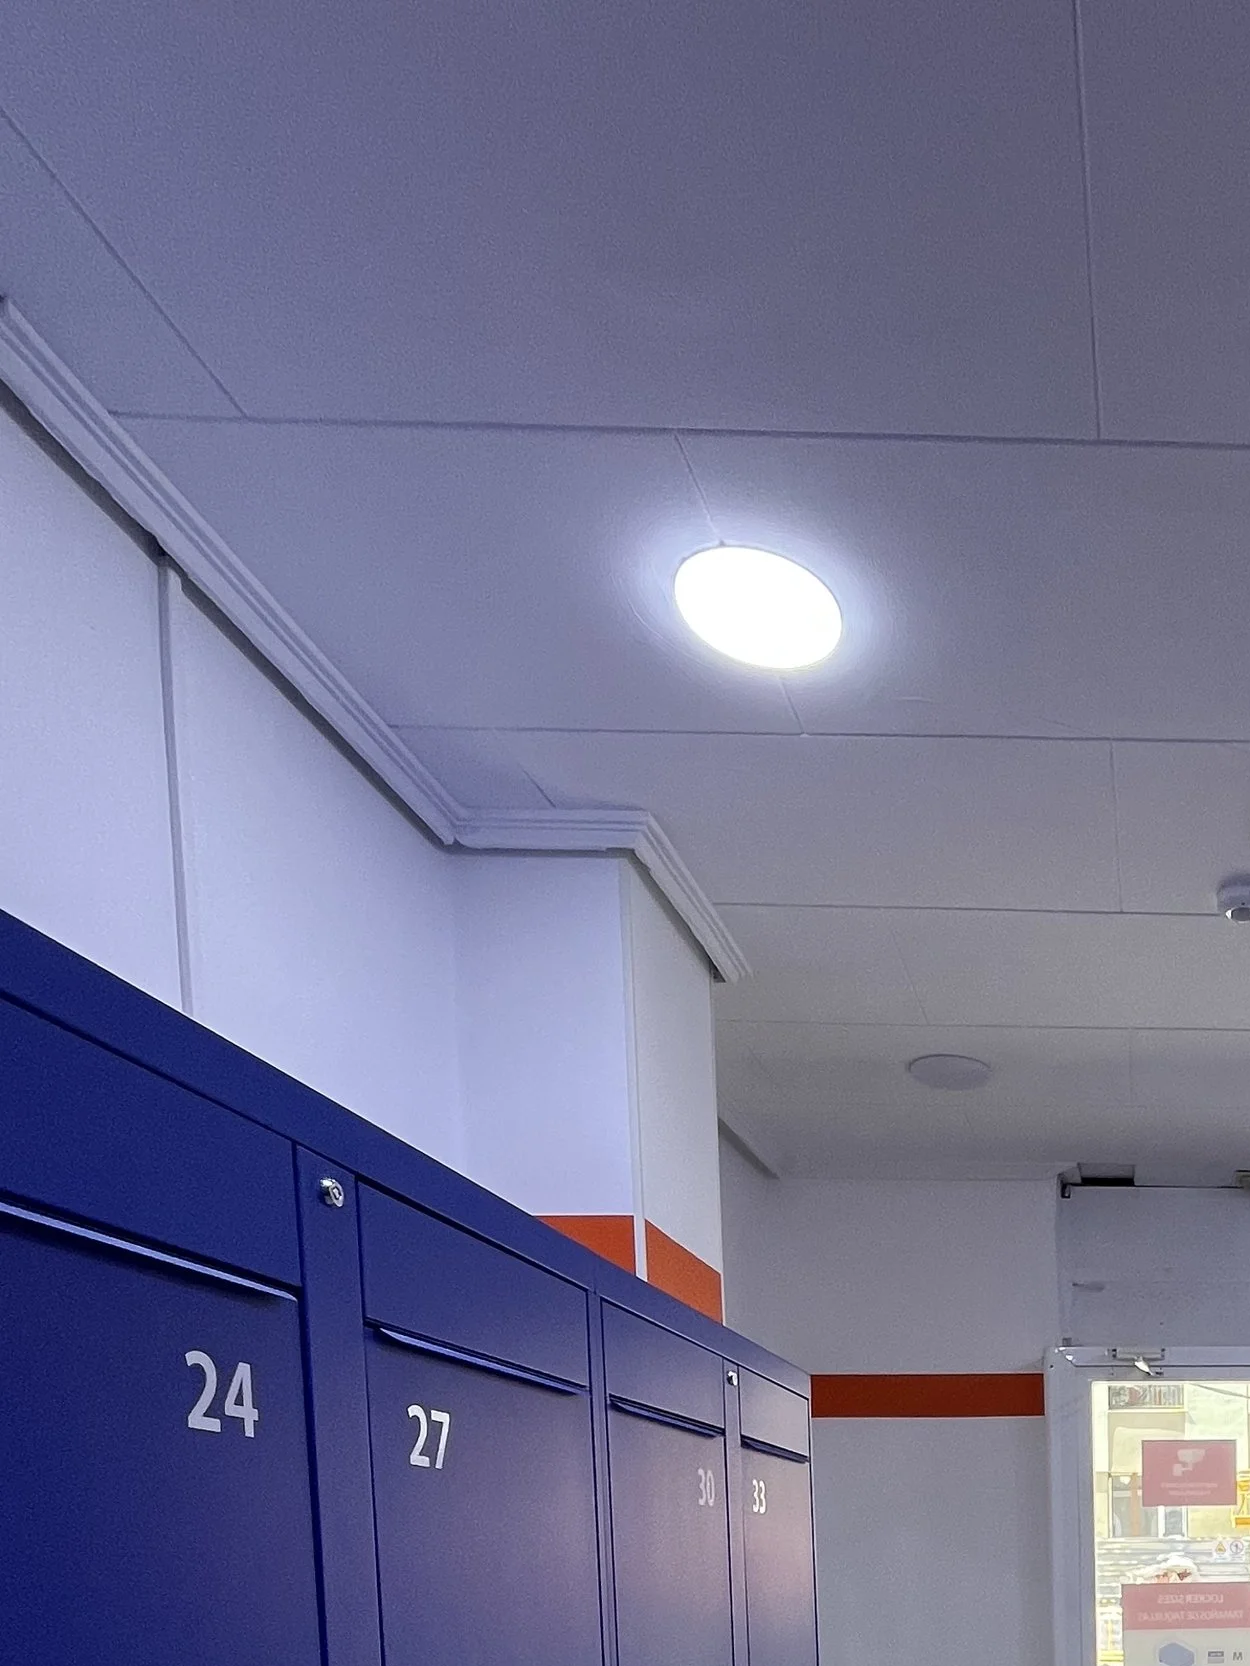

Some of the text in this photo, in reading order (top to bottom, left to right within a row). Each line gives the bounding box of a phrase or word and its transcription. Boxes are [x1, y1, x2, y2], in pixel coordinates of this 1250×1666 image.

[184, 1350, 259, 1438] 24
[407, 1404, 450, 1470] 27
[697, 1468, 715, 1507] 30
[752, 1479, 766, 1514] 33
